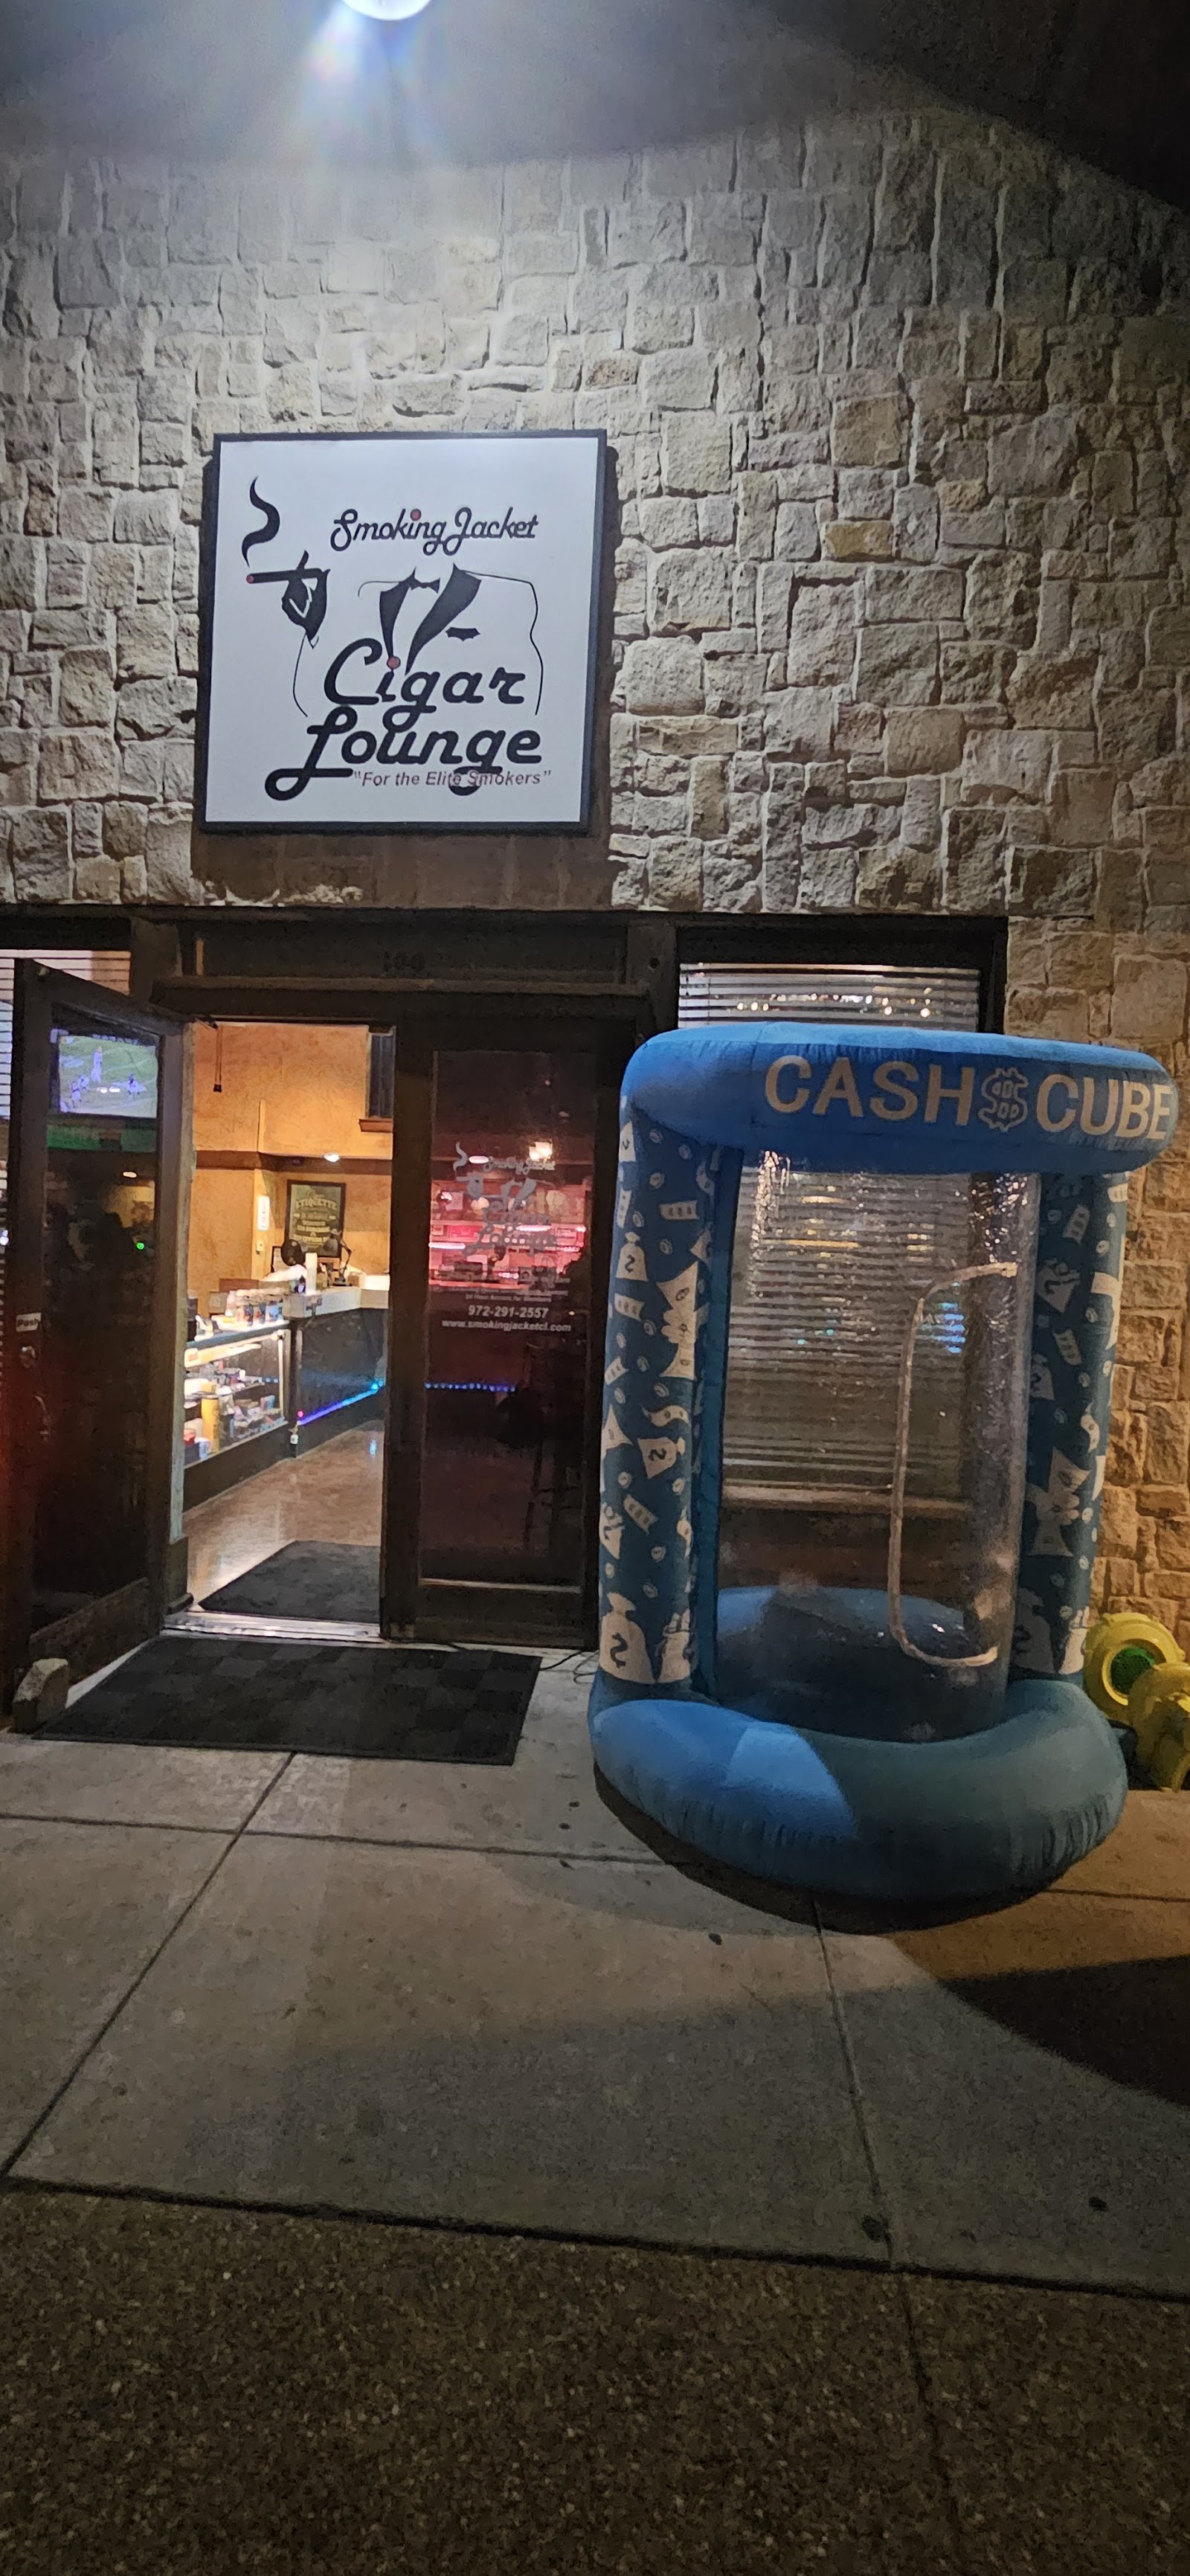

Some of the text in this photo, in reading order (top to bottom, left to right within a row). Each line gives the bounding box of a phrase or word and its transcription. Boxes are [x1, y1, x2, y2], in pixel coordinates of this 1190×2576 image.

[330, 507, 539, 556] Smoking Jacket
[324, 637, 526, 731] Cigar
[264, 704, 542, 801] Lounge
[395, 771, 419, 786] the
[425, 771, 462, 786] Elite
[765, 1054, 976, 1126] CASH
[1036, 1073, 1173, 1140] CUBE
[468, 1304, 550, 1319] 972-291-2557
